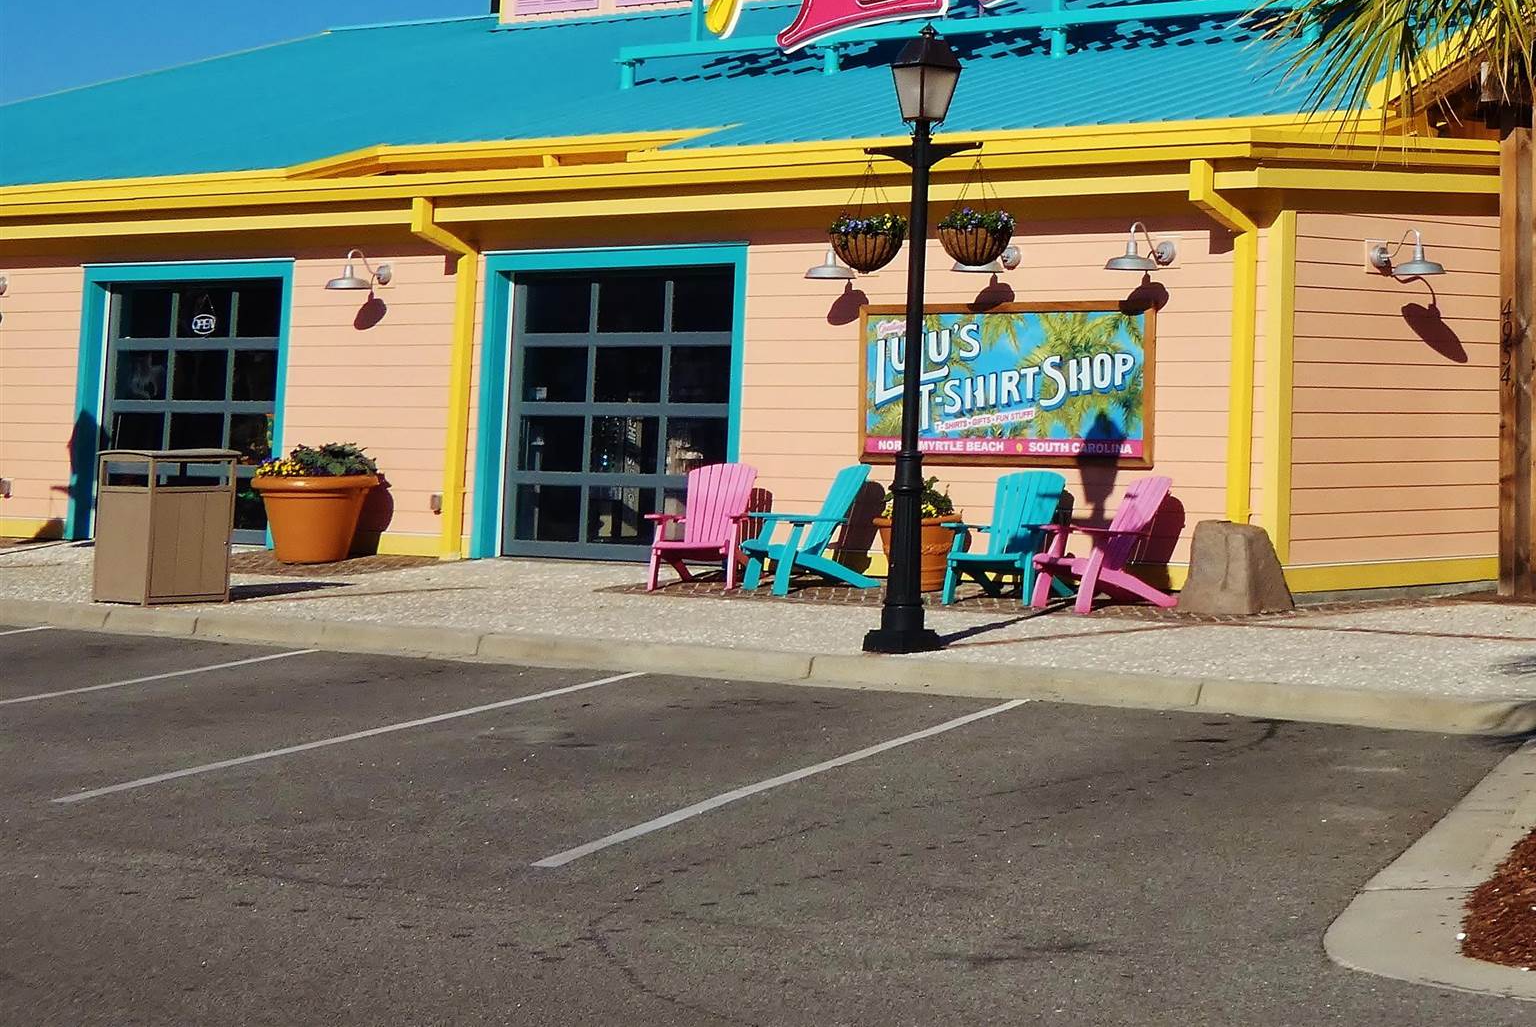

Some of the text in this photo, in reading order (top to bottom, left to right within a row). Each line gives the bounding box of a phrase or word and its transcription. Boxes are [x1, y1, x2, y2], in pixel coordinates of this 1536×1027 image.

[192, 318, 215, 330] OPEN
[1040, 353, 1136, 409] SHOP
[917, 440, 964, 452] MYRTLE
[965, 441, 1004, 452] BEACH
[1028, 441, 1133, 455] SOUTH CAROLINA
